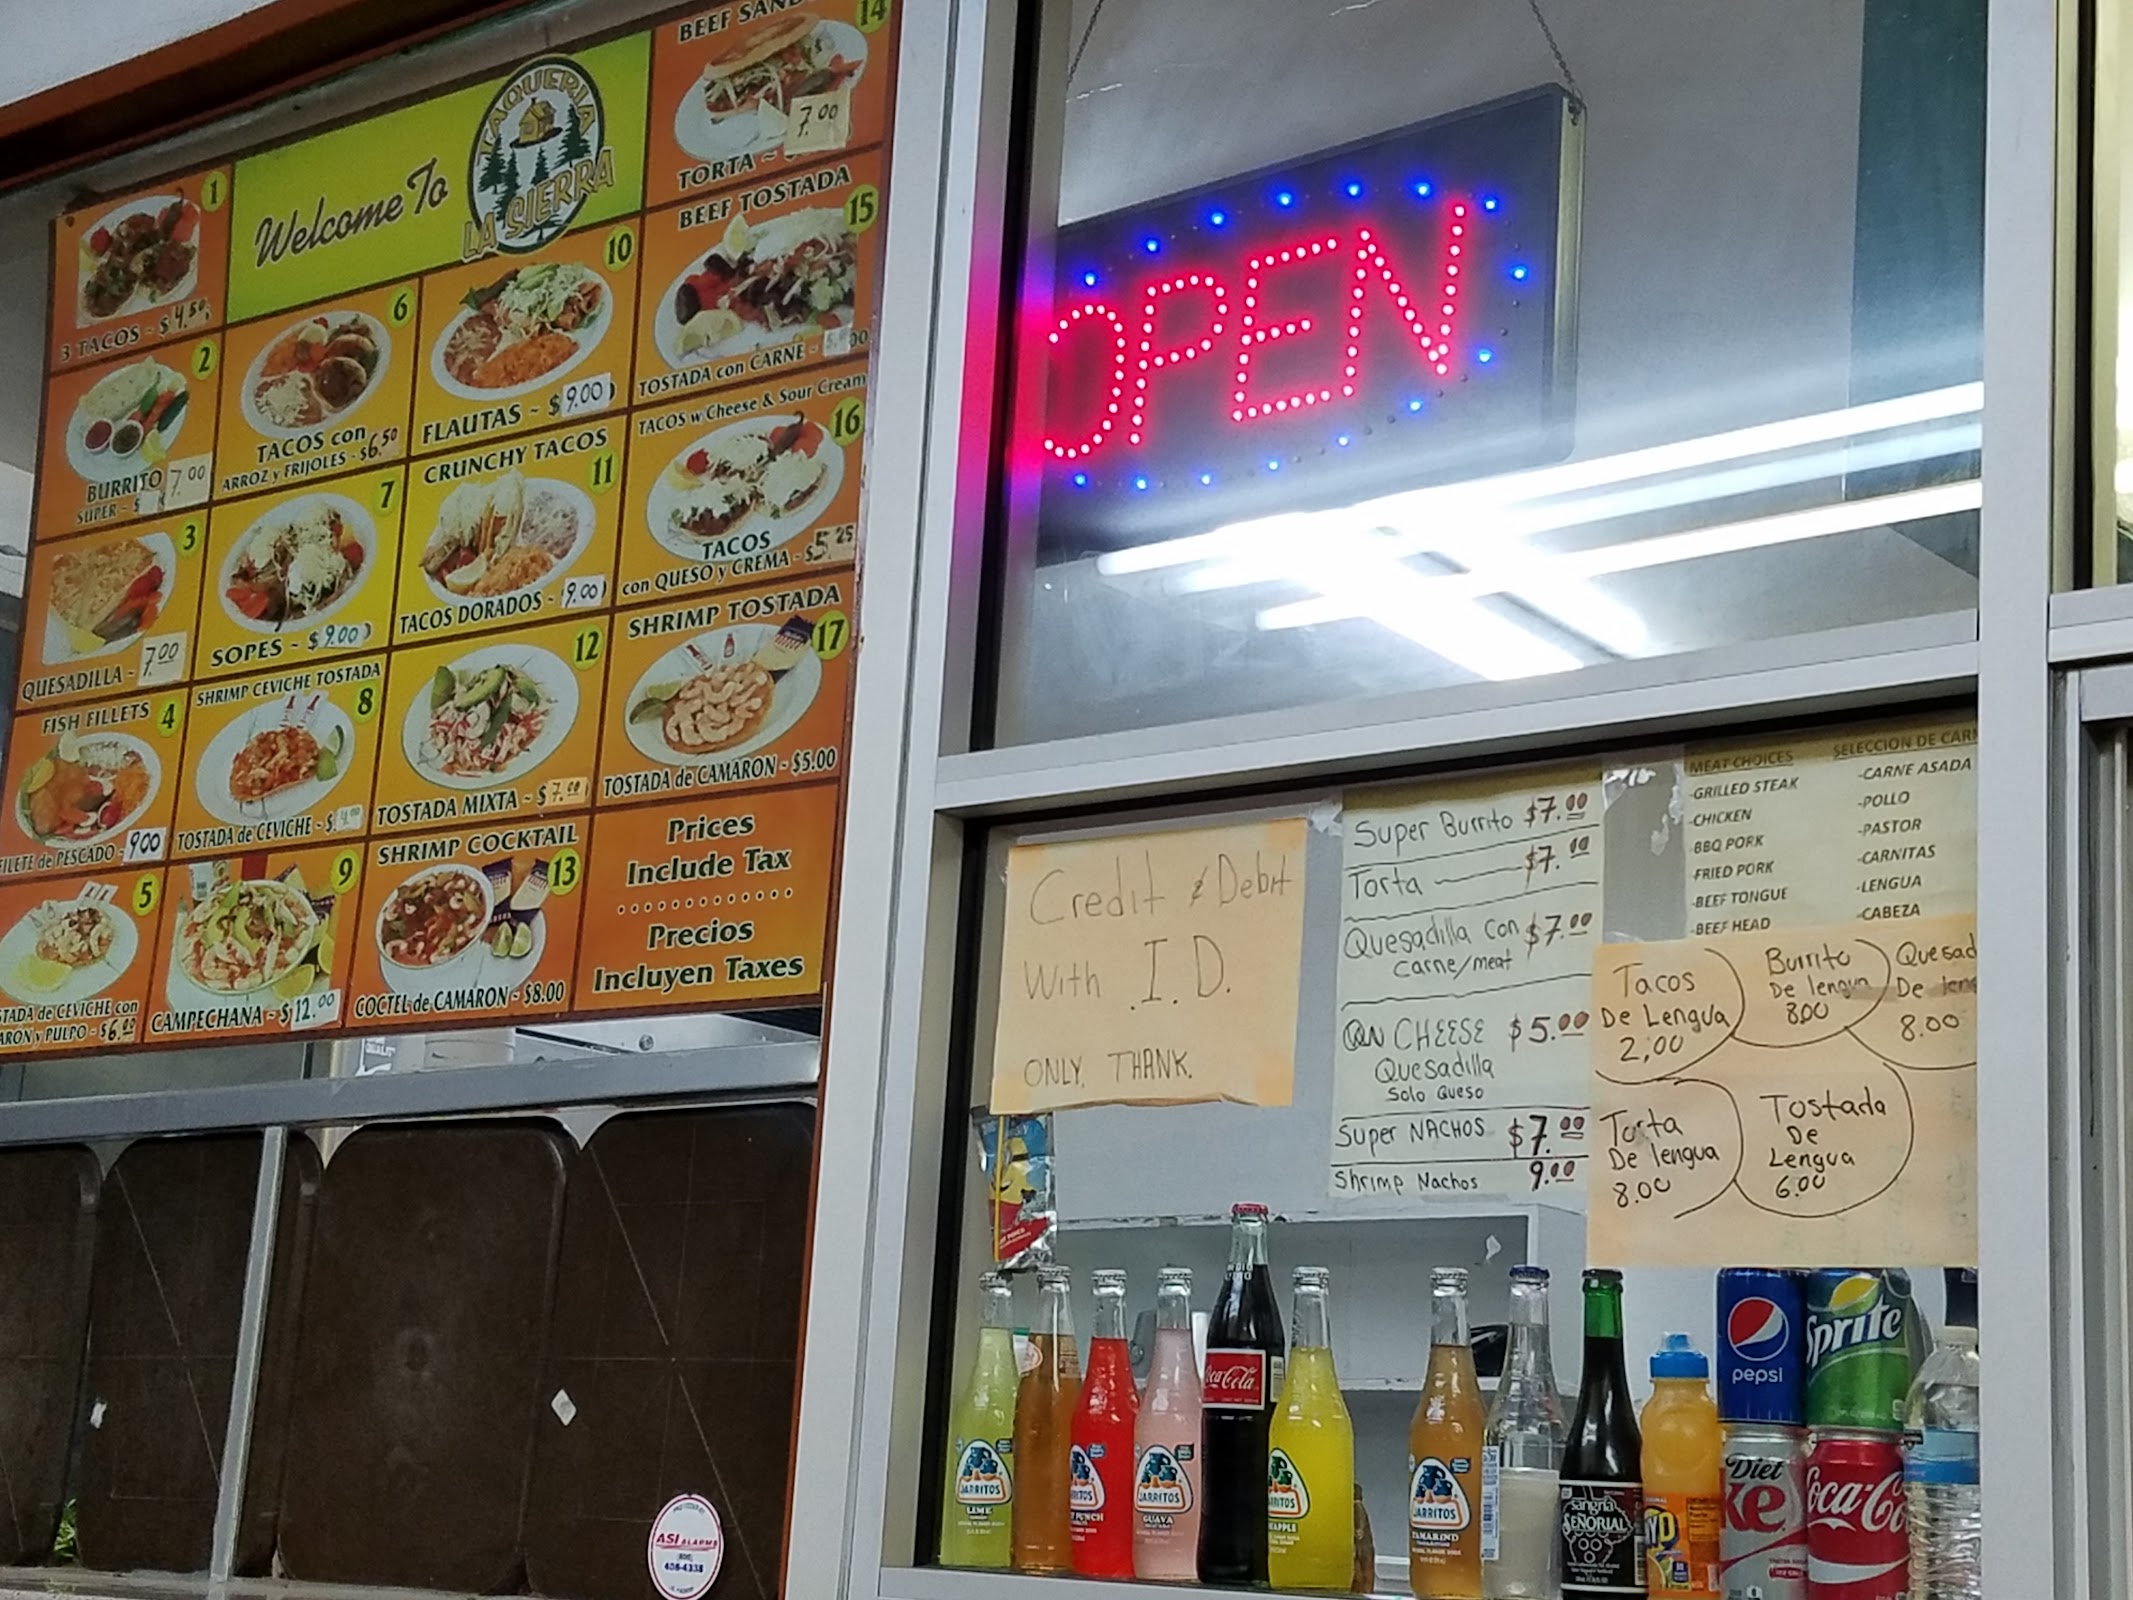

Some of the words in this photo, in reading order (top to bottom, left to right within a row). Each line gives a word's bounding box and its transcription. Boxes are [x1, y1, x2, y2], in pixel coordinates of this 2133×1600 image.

[679, 10, 731, 42] BEEF
[861, 0, 887, 26] 14
[477, 68, 597, 167] TAQUERIA
[797, 104, 839, 138] 7.00
[679, 153, 753, 189] TORTA
[254, 196, 403, 268] Welcome
[406, 157, 449, 215] To
[463, 212, 498, 258] LA
[505, 149, 615, 240] SIERRA
[680, 198, 731, 229] BEEF
[741, 166, 850, 211] TOSTADA
[850, 191, 874, 225] 15
[608, 232, 632, 265] 10
[393, 292, 408, 321] 6
[78, 326, 140, 357] TACOS
[1044, 203, 1467, 462] OPEN
[198, 346, 211, 373] 2
[638, 367, 711, 397] TOSTADA
[717, 363, 744, 378] con
[750, 344, 804, 370] CARNE
[638, 411, 686, 436] TACOS
[706, 397, 758, 421] Cheese
[762, 393, 774, 407] &
[780, 386, 813, 404] Sour
[818, 374, 867, 395] Cream
[833, 403, 861, 438] 16
[422, 404, 521, 444] FLAUTAS
[256, 432, 323, 463] TACOS
[331, 427, 366, 446] con
[424, 446, 527, 484] CRUNCHY
[534, 428, 608, 460] TACOS
[87, 470, 162, 503] BURRITO
[169, 465, 206, 498] 7.00
[222, 470, 268, 491] ARROZ
[284, 453, 346, 479] FRIJOLES
[592, 454, 613, 486] 11
[380, 480, 395, 508] 7
[77, 503, 117, 525] SUPER
[183, 525, 196, 550] 3
[702, 531, 771, 560] TACOS
[622, 578, 649, 595] con
[654, 565, 713, 590] QUESO
[732, 550, 789, 576] CREMA
[400, 608, 452, 634] TACOS
[458, 591, 543, 624] DORADOS
[628, 607, 719, 638] SHRIMP
[728, 585, 840, 621] TOSTADA
[575, 630, 599, 662] 12
[818, 619, 845, 651] 17
[211, 638, 282, 667] SOPES
[22, 666, 122, 702] QUESADILLA
[143, 642, 180, 677] 7.00
[197, 685, 249, 706] SHRIMP
[253, 674, 311, 696] CEVICHE
[316, 662, 381, 686] TOSTADA
[161, 703, 175, 729] 4
[357, 687, 374, 716] 8
[43, 714, 80, 735] FISH
[86, 702, 149, 728] FILLETS
[1833, 737, 1912, 758] SELECCION
[1917, 732, 1937, 748] DE
[604, 771, 670, 797] TOSTADA
[675, 768, 693, 787] de
[698, 756, 776, 785] CAMARON
[793, 749, 836, 773] $5.00
[1689, 757, 1731, 774] MEAT
[1734, 749, 1794, 769] CHOICES
[1917, 757, 1972, 774] ASADA
[1753, 776, 1800, 794] STEAK
[377, 799, 457, 826] TOSTADA
[462, 790, 518, 815] MIXTA
[178, 826, 234, 850] TOSTADA
[238, 826, 252, 842] de
[256, 816, 312, 841] CEVICHE
[378, 838, 460, 865] SHRIMP
[467, 825, 578, 854] COCKTAIL
[667, 816, 754, 843] Prices
[1353, 820, 1430, 857] Super
[1439, 808, 1513, 838] Burrito
[1725, 835, 1764, 851] PORK
[38, 853, 52, 869] de
[56, 845, 115, 866] PESCADO
[339, 857, 354, 885] 9
[553, 856, 576, 887] 13
[627, 853, 733, 886] Include
[745, 847, 791, 873] Tax
[1736, 861, 1774, 877] PORK
[138, 881, 153, 909] 5
[1030, 850, 1166, 925] Credit
[1348, 866, 1424, 900] Torta
[1730, 887, 1789, 905] TONGUE
[648, 919, 754, 949] Precios
[1344, 915, 1472, 959] Quesadilla
[1731, 917, 1771, 932] HEAD
[593, 964, 713, 993] Incluyen
[725, 956, 804, 982] Taxes
[1765, 943, 1852, 977] Burrito
[1023, 960, 1101, 1001] With
[1613, 962, 1696, 997] Tacos
[1769, 981, 1795, 999] De
[1896, 976, 1924, 999] De
[37, 1006, 53, 1020] de
[57, 1000, 111, 1019] CEVICHE
[115, 1001, 138, 1014] con
[355, 994, 408, 1018] COCTEL
[413, 992, 430, 1012] de
[434, 986, 509, 1012] CAMARON
[524, 981, 565, 1005] $8.00
[45, 1025, 87, 1042] PULPO
[151, 1005, 262, 1032] CAMPECHANA
[1601, 1007, 1631, 1029] De
[1646, 1003, 1731, 1033] Lengua
[1900, 1013, 1960, 1042] 8.00
[1394, 1018, 1486, 1052] CHEESE
[1375, 1050, 1496, 1083] Quesadilla
[1760, 1086, 1888, 1124] Tostada
[1335, 1124, 1398, 1158] Super
[1410, 1117, 1486, 1144] NACHOS
[1600, 1108, 1684, 1148] Torta
[1786, 1126, 1819, 1146] De
[1609, 1147, 1638, 1171] De
[1769, 1147, 1856, 1176] Lengua
[1334, 1168, 1404, 1196] Shrimp
[1417, 1172, 1479, 1191] Nachos
[1613, 1177, 1671, 1208] 8.00
[1775, 1175, 1826, 1199] 6.00
[1806, 1295, 1902, 1368] Sprite
[1732, 1367, 1783, 1385] pepsi
[1725, 1453, 1785, 1481] Diet
[960, 1484, 1001, 1496] JARRITOS
[1138, 1492, 1181, 1504] JARRITOS
[1413, 1507, 1457, 1521] JARRITOS
[656, 1533, 680, 1545] ASI
